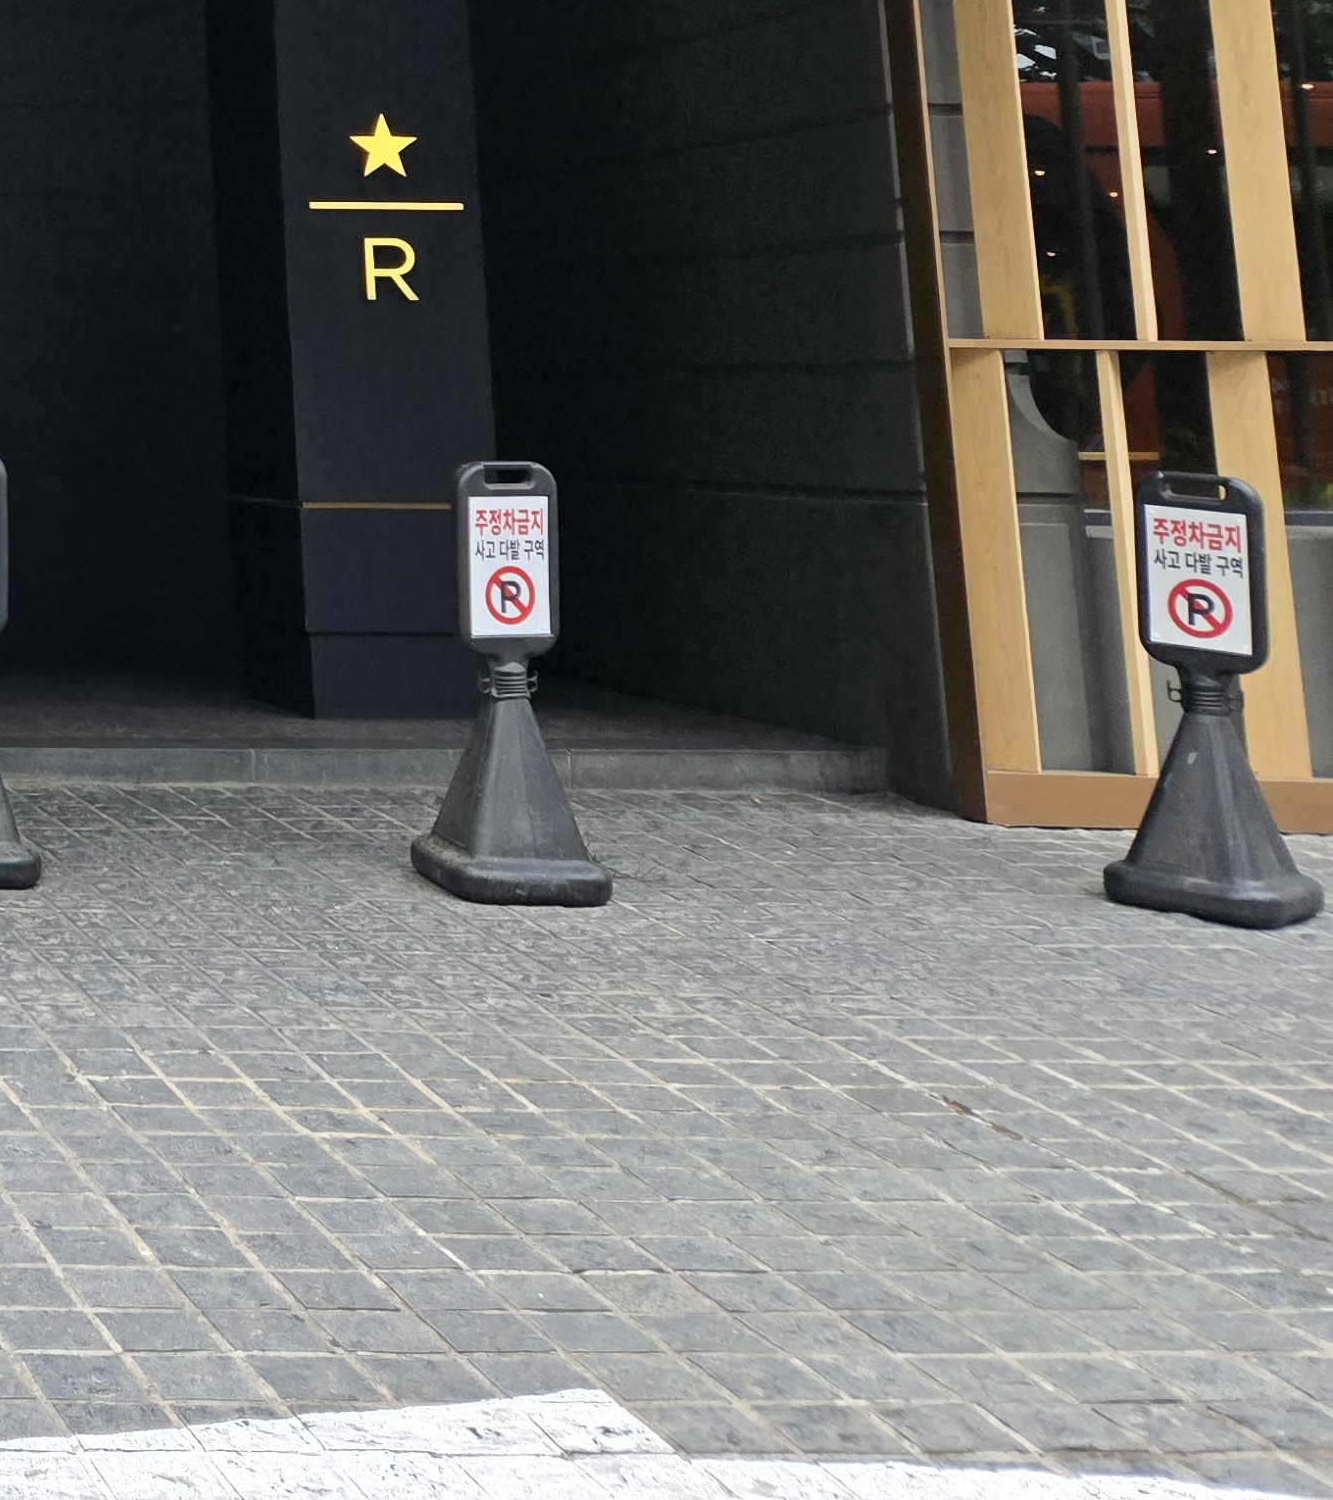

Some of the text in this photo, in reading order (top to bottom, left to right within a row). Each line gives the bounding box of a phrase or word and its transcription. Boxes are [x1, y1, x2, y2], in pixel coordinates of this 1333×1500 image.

[363, 237, 420, 301] R
[475, 508, 544, 536] 주정차금지
[1152, 517, 1242, 554] 주정차금지
[475, 539, 545, 561] 사고 다발 구역
[1154, 549, 1244, 579] 사고 다발 구역
[501, 580, 522, 613] P
[1187, 592, 1215, 626] P
